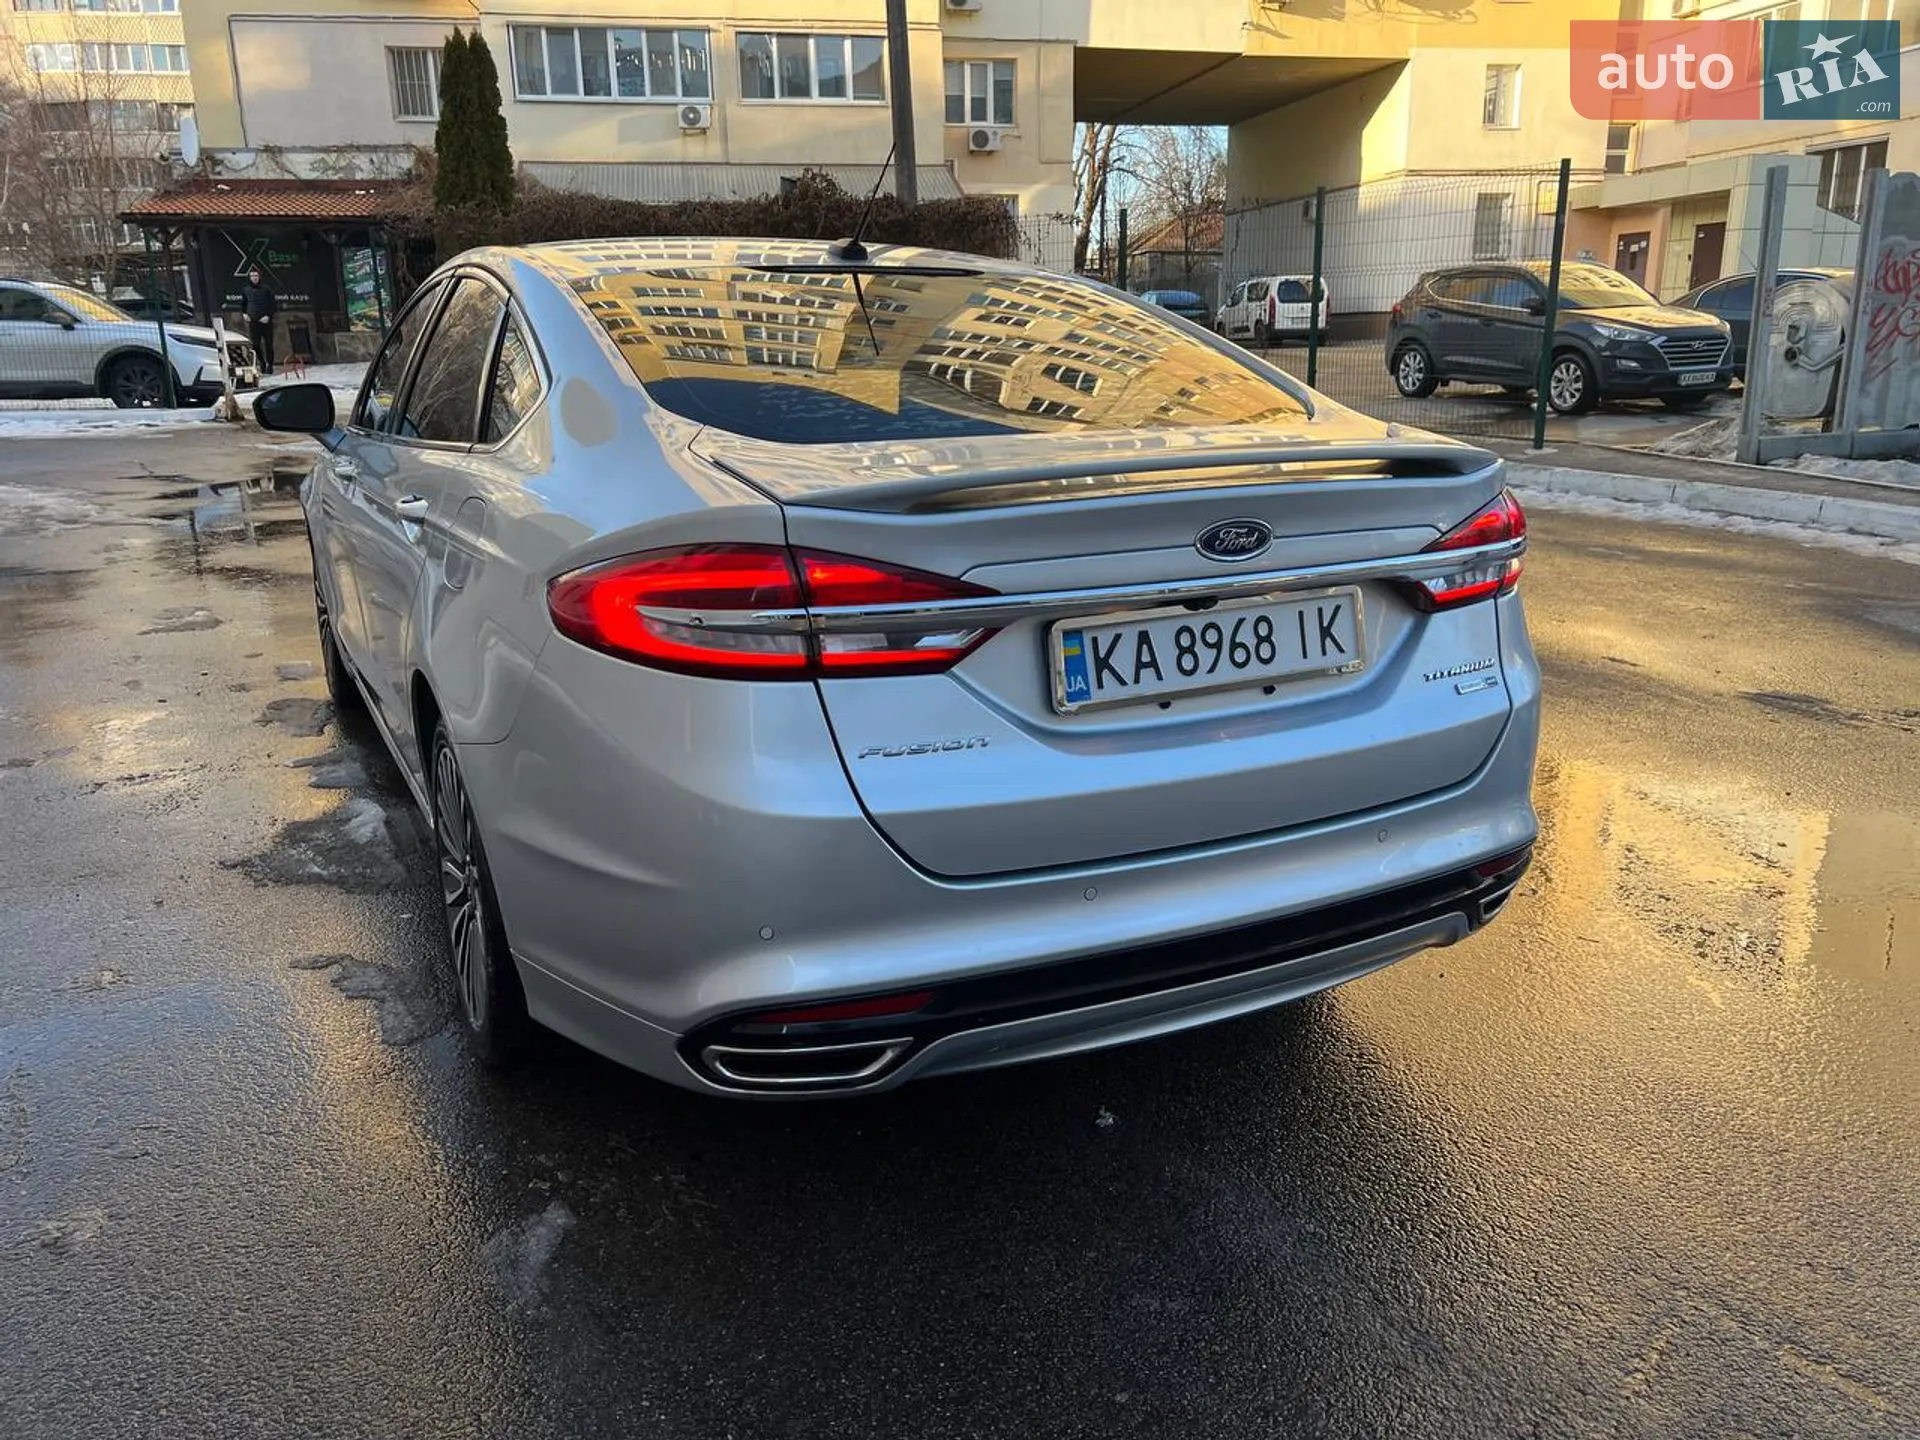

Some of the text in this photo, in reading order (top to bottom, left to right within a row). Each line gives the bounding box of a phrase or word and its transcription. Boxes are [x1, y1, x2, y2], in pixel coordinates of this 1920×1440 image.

[1214, 527, 1259, 552] Ford
[1091, 603, 1346, 690] KA 8968 IK
[1065, 675, 1088, 692] UA
[858, 736, 990, 759] FUSION
